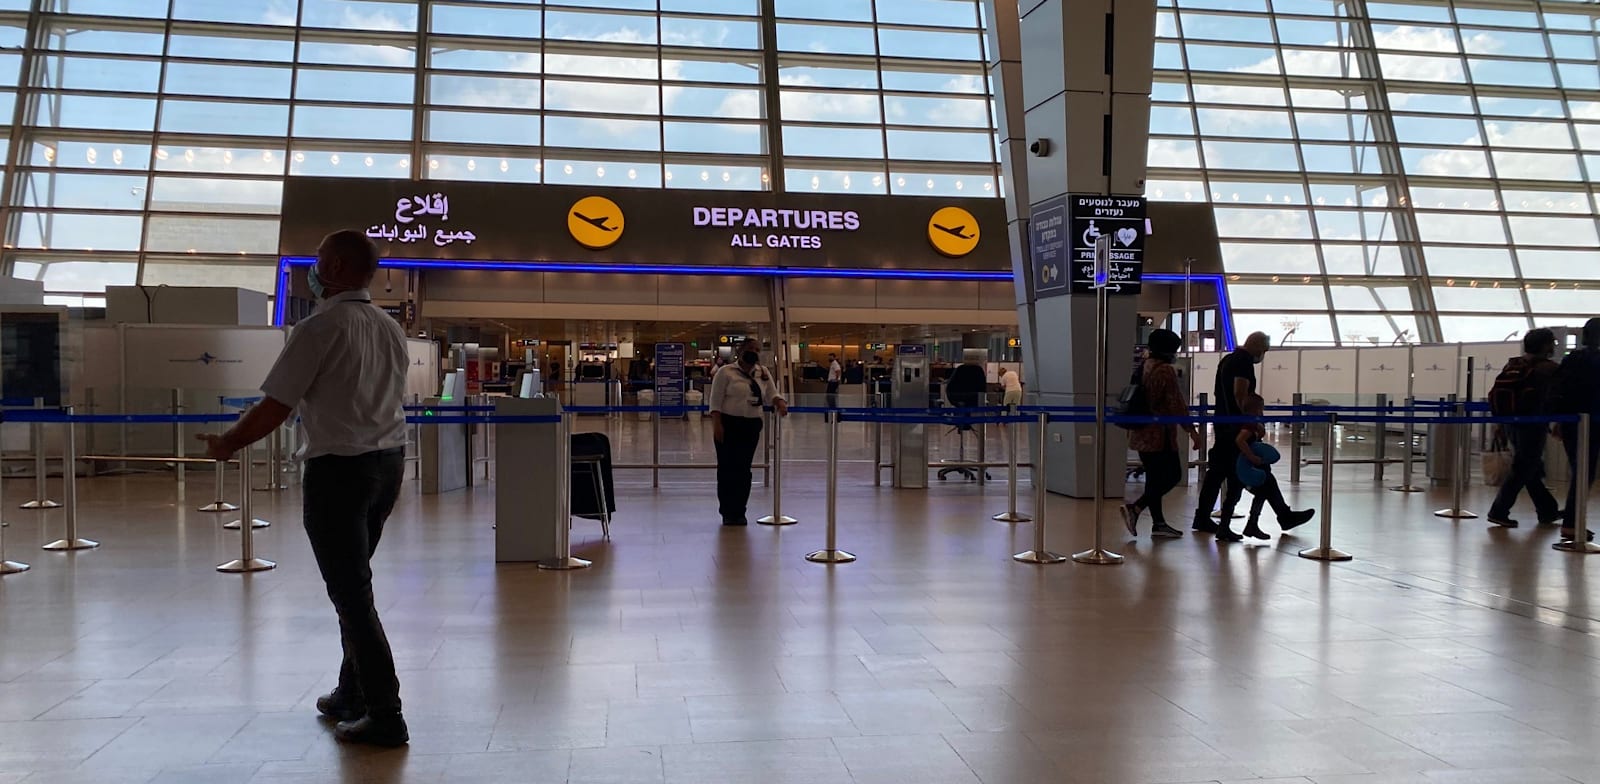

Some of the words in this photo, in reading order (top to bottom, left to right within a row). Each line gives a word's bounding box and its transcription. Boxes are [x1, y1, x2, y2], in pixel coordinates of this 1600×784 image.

[395, 192, 449, 223] إقلاع
[1079, 197, 1114, 207] לנוסעים
[1116, 199, 1140, 208] מעבר
[693, 206, 860, 231] DEPARTURES
[1095, 208, 1124, 217] נעזרים
[365, 223, 427, 243] البوابات
[434, 228, 476, 247] جميع
[731, 233, 762, 247] ALL
[766, 234, 822, 249] GATES
[1109, 252, 1135, 260] SSAGE
